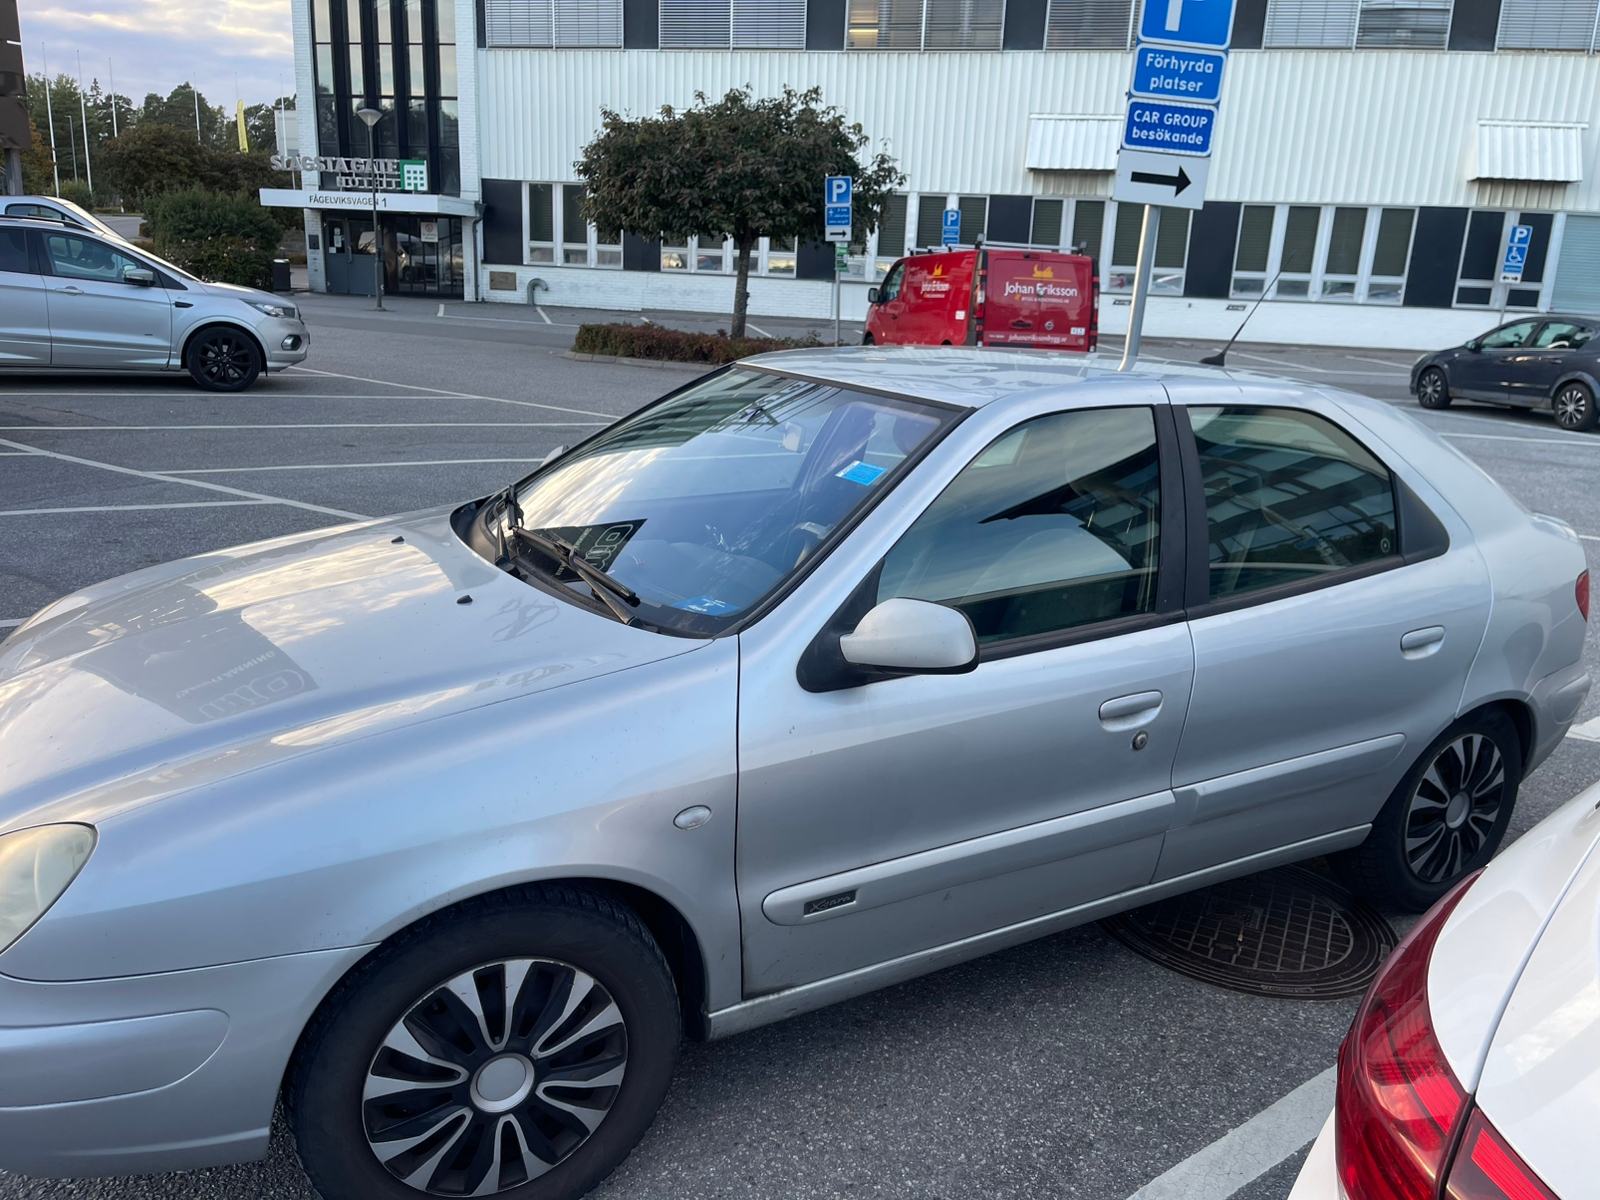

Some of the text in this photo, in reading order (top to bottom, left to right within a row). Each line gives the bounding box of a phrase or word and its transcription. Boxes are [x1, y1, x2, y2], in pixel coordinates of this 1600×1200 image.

[1145, 53, 1214, 74] Förhyrda
[1149, 75, 1204, 92] platser
[1133, 110, 1208, 128] CAR GROUP
[1132, 127, 1204, 145] besökande
[832, 179, 847, 202] P
[381, 197, 387, 208] 1
[947, 211, 958, 226] P
[1514, 228, 1528, 244] P
[1004, 281, 1078, 298] Johan Eriksson
